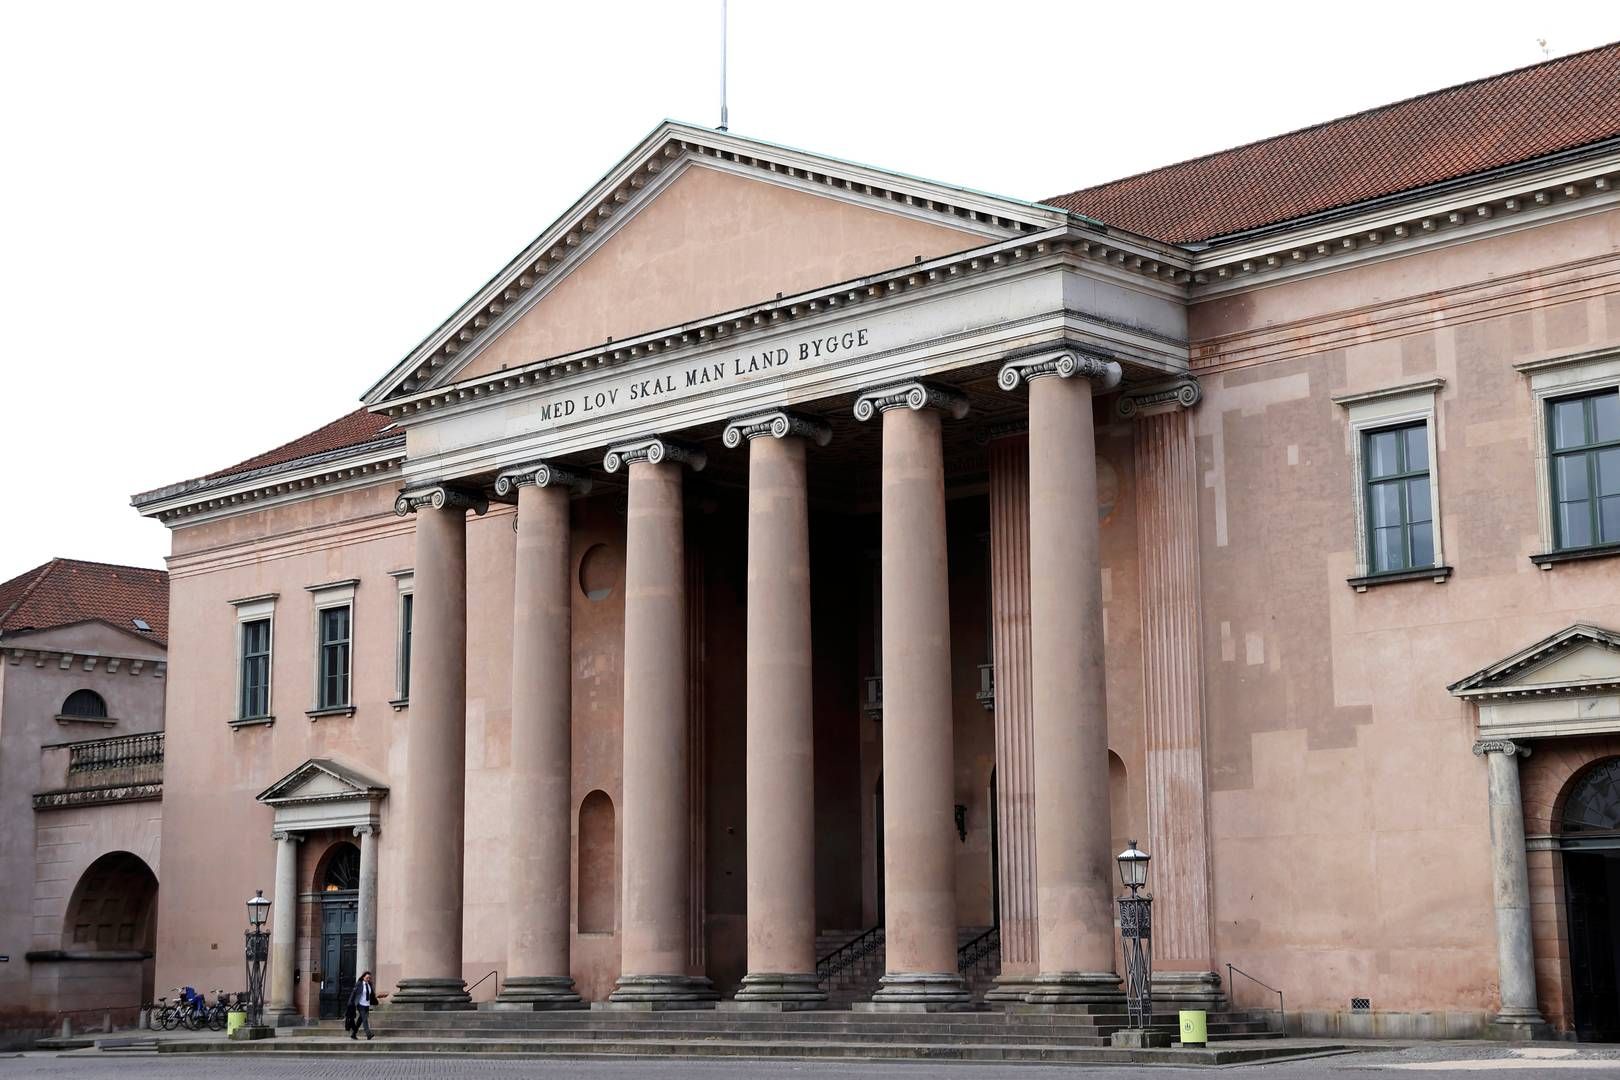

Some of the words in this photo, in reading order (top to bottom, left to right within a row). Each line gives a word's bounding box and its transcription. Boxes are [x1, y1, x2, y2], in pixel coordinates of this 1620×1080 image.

[540, 399, 575, 422] MED
[583, 388, 619, 412] LOV
[630, 375, 677, 400] SKAL
[685, 362, 726, 388] MAN
[734, 348, 790, 376] LAND
[799, 328, 869, 361] BYGGE
